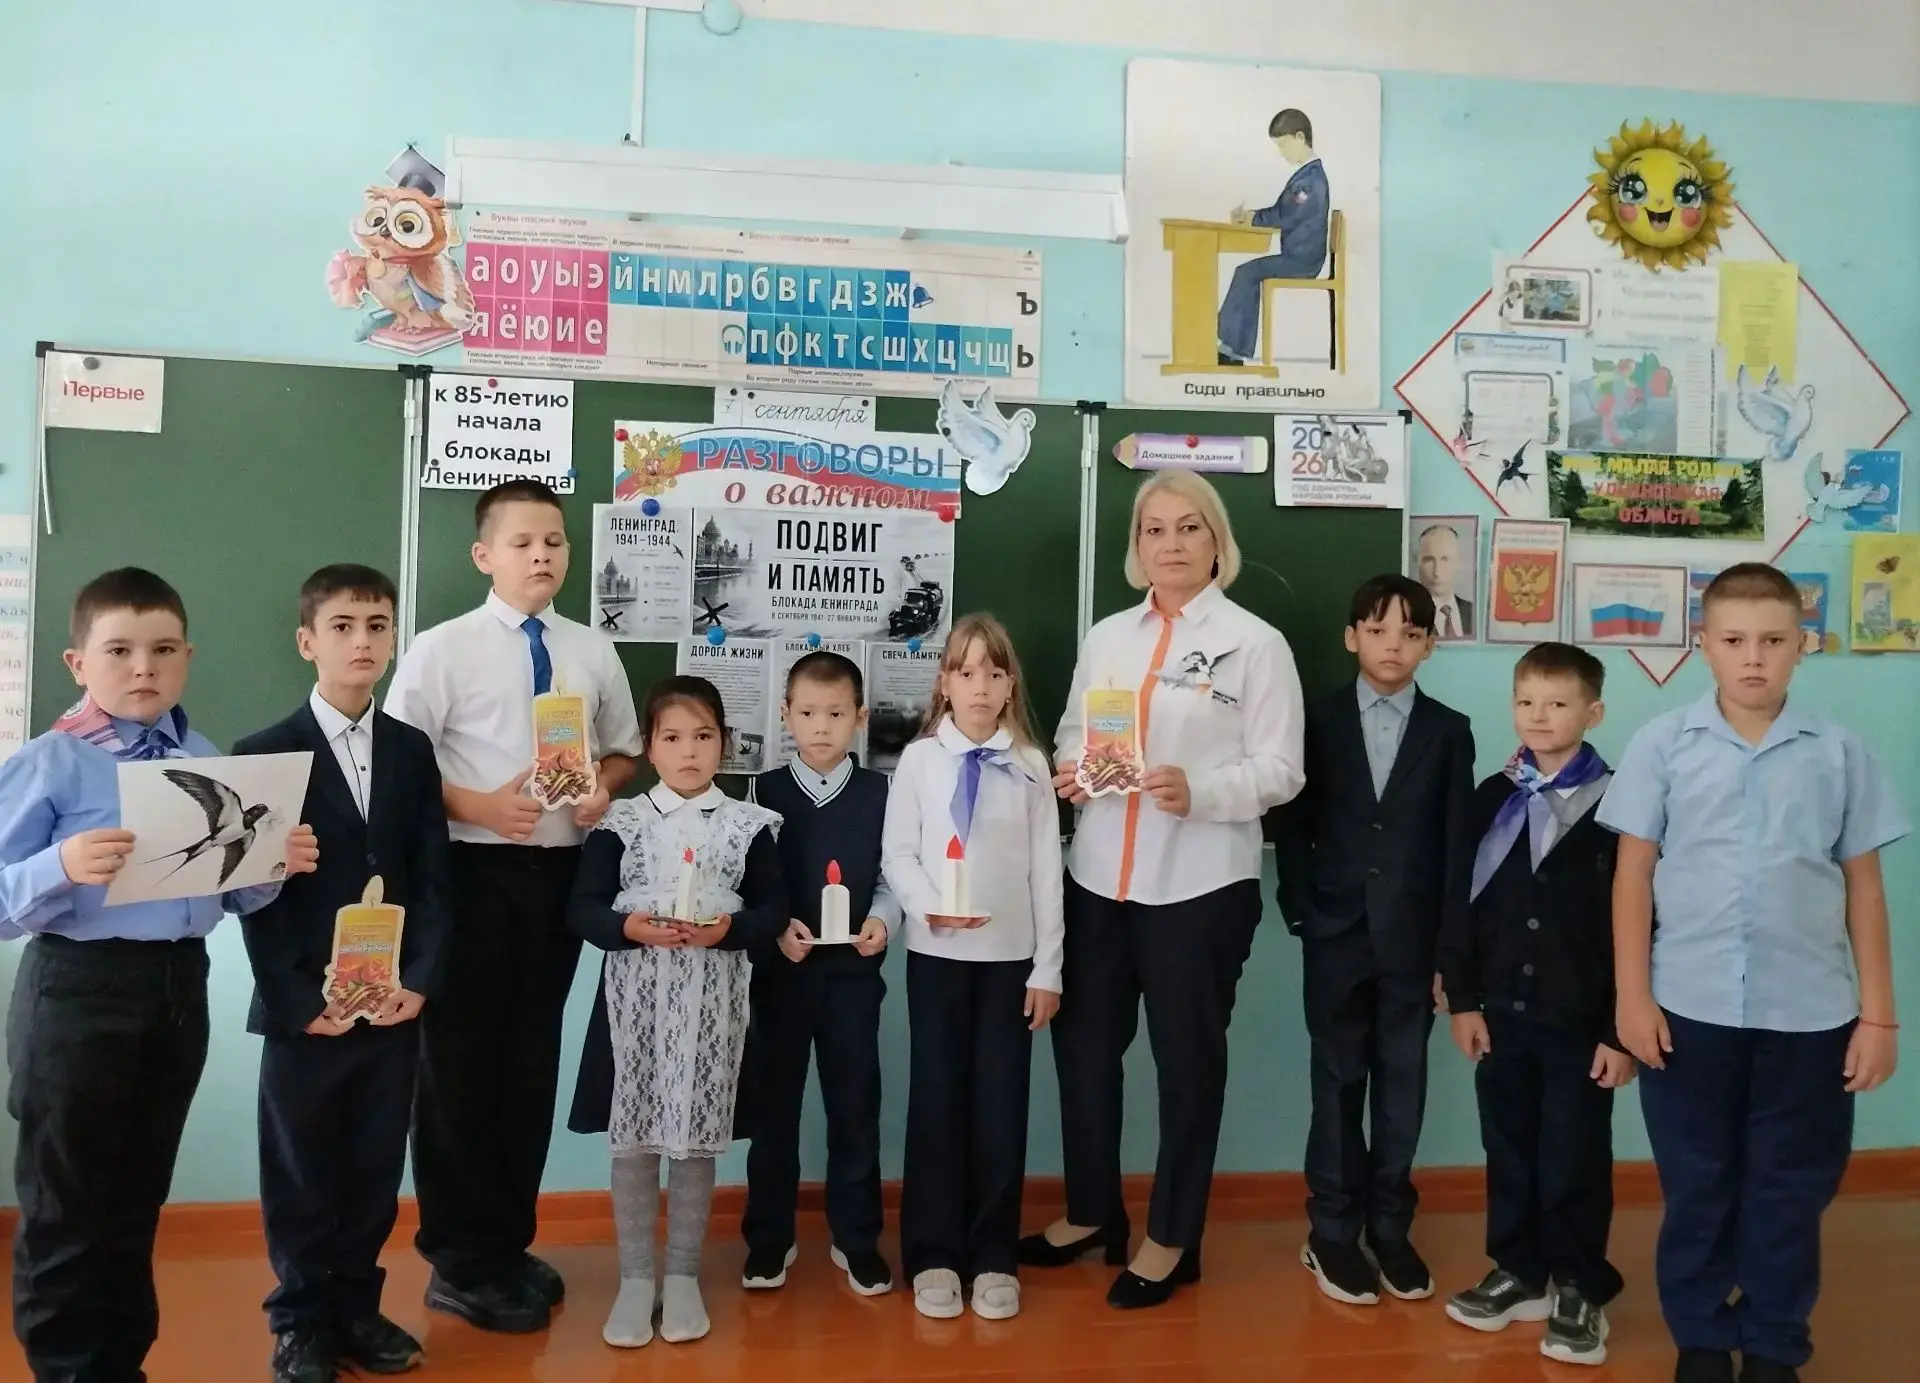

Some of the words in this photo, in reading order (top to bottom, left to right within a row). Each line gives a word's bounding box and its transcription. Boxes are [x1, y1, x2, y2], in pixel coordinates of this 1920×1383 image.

[1016, 291, 1038, 316] ъ
[1016, 344, 1034, 369] ь
[63, 380, 145, 402] Первые
[435, 388, 447, 402] к
[454, 385, 569, 408] 85-летию
[1184, 382, 1226, 398] Сиди
[1236, 385, 1325, 399] правильно
[457, 414, 541, 431] начала
[754, 396, 869, 431] сентября
[1292, 427, 1323, 450] 20
[444, 441, 551, 465] блокады
[698, 437, 945, 478] РАЗГОВОРЫ
[1141, 450, 1192, 461] Домашнее
[1195, 453, 1235, 463] задание
[1292, 452, 1324, 475] 26
[725, 482, 746, 504] о
[766, 482, 932, 511] важном
[776, 519, 884, 555] ПОДВИГ
[768, 563, 781, 590] И
[792, 564, 885, 594] ПАМЯТЬ
[771, 596, 817, 609] БЛОКАДА
[820, 598, 879, 612] ЛЕНИНГРАДА
[691, 645, 727, 658] ДОРОГА
[730, 647, 764, 660] ЖИЗНИ
[832, 643, 851, 653] ХЛЕБ
[882, 650, 908, 661] СВЕЧА
[910, 651, 942, 661] ПАМЯТИ
